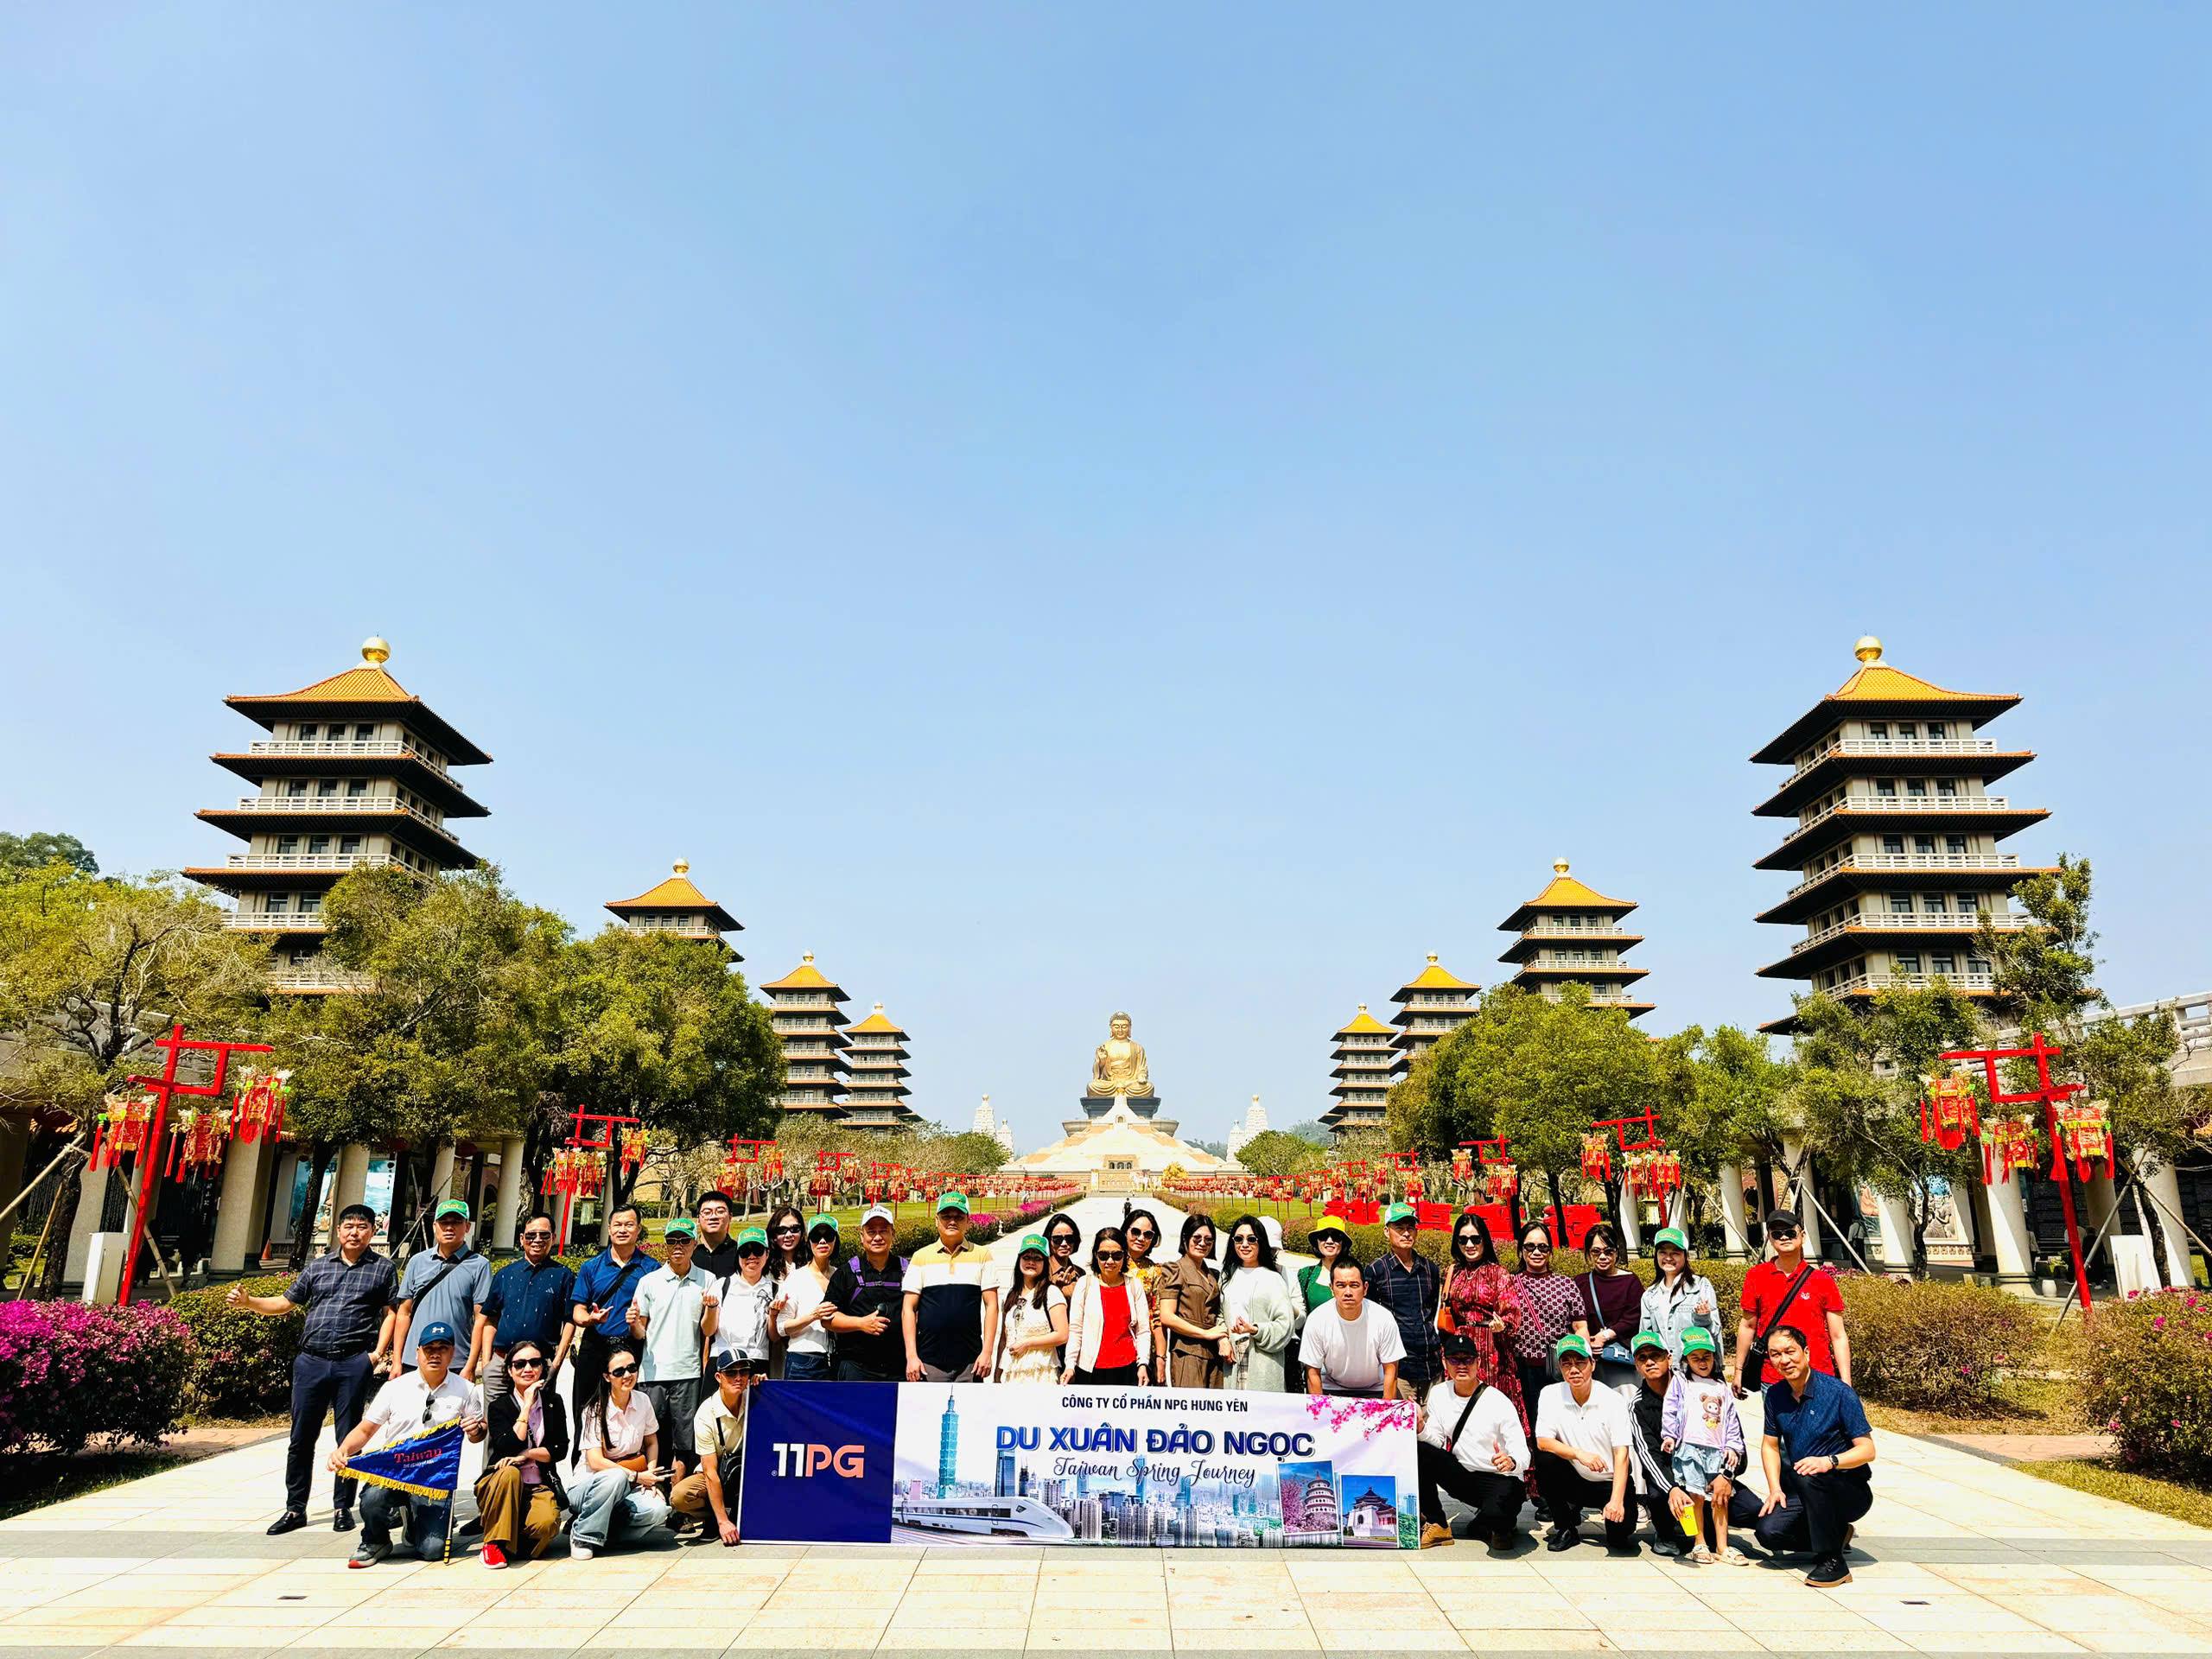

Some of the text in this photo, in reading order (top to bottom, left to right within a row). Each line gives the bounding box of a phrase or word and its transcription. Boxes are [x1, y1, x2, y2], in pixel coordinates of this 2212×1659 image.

[1062, 1393, 1248, 1412] CÔNG TY CỔ PHẦN NPG HƯNG YÊN
[996, 1422, 1315, 1462] DU XUÂN ĐẢO NGỌC
[394, 1448, 442, 1463] Taiwan
[1053, 1457, 1255, 1488] Taiwan Spring Journey
